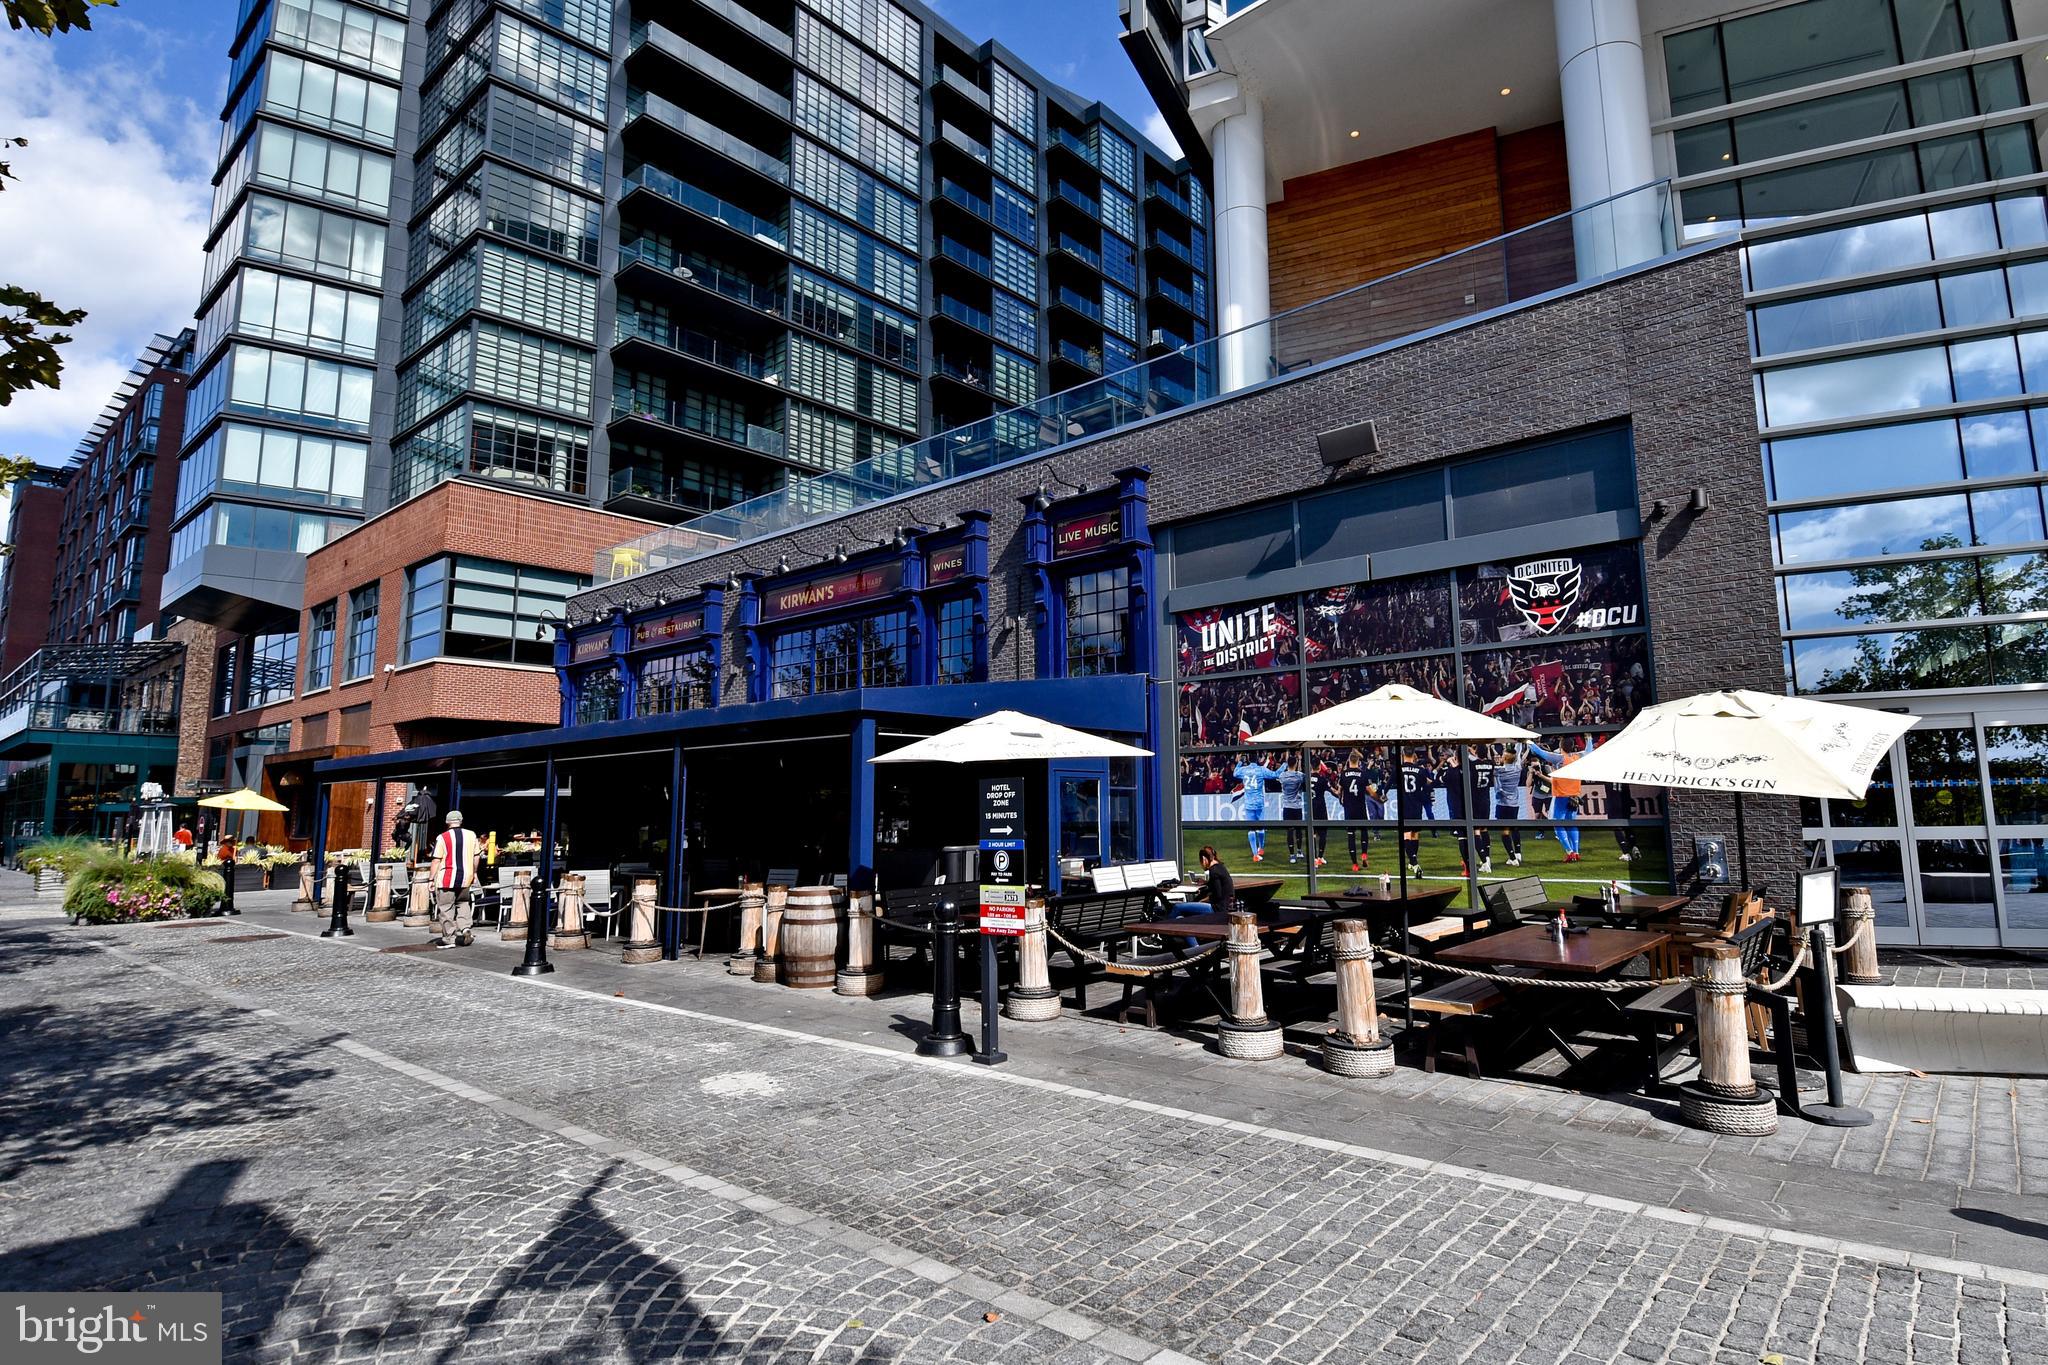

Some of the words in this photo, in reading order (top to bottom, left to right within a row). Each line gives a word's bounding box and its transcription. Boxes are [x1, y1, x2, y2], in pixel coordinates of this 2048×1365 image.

[1059, 529, 1081, 544] LIVE
[1085, 521, 1119, 538] MUSIC
[933, 558, 962, 572] WINES
[780, 585, 834, 610] KIRWAN'S
[1576, 605, 1638, 628] #DCU
[576, 638, 609, 655] KIRWAN'S
[636, 630, 649, 640] PUB
[657, 618, 702, 636] RESTAURANT
[1201, 602, 1276, 652] UNITE
[1204, 657, 1215, 667] THE
[1216, 634, 1277, 667] DISTRICT
[1243, 775, 1258, 790] 24
[1349, 779, 1358, 796] 4
[1404, 774, 1417, 793] 13
[1477, 771, 1490, 788] 15
[1622, 771, 1738, 788] HENDRICK'S
[1741, 778, 1778, 790] GIN
[985, 812, 991, 820] 15
